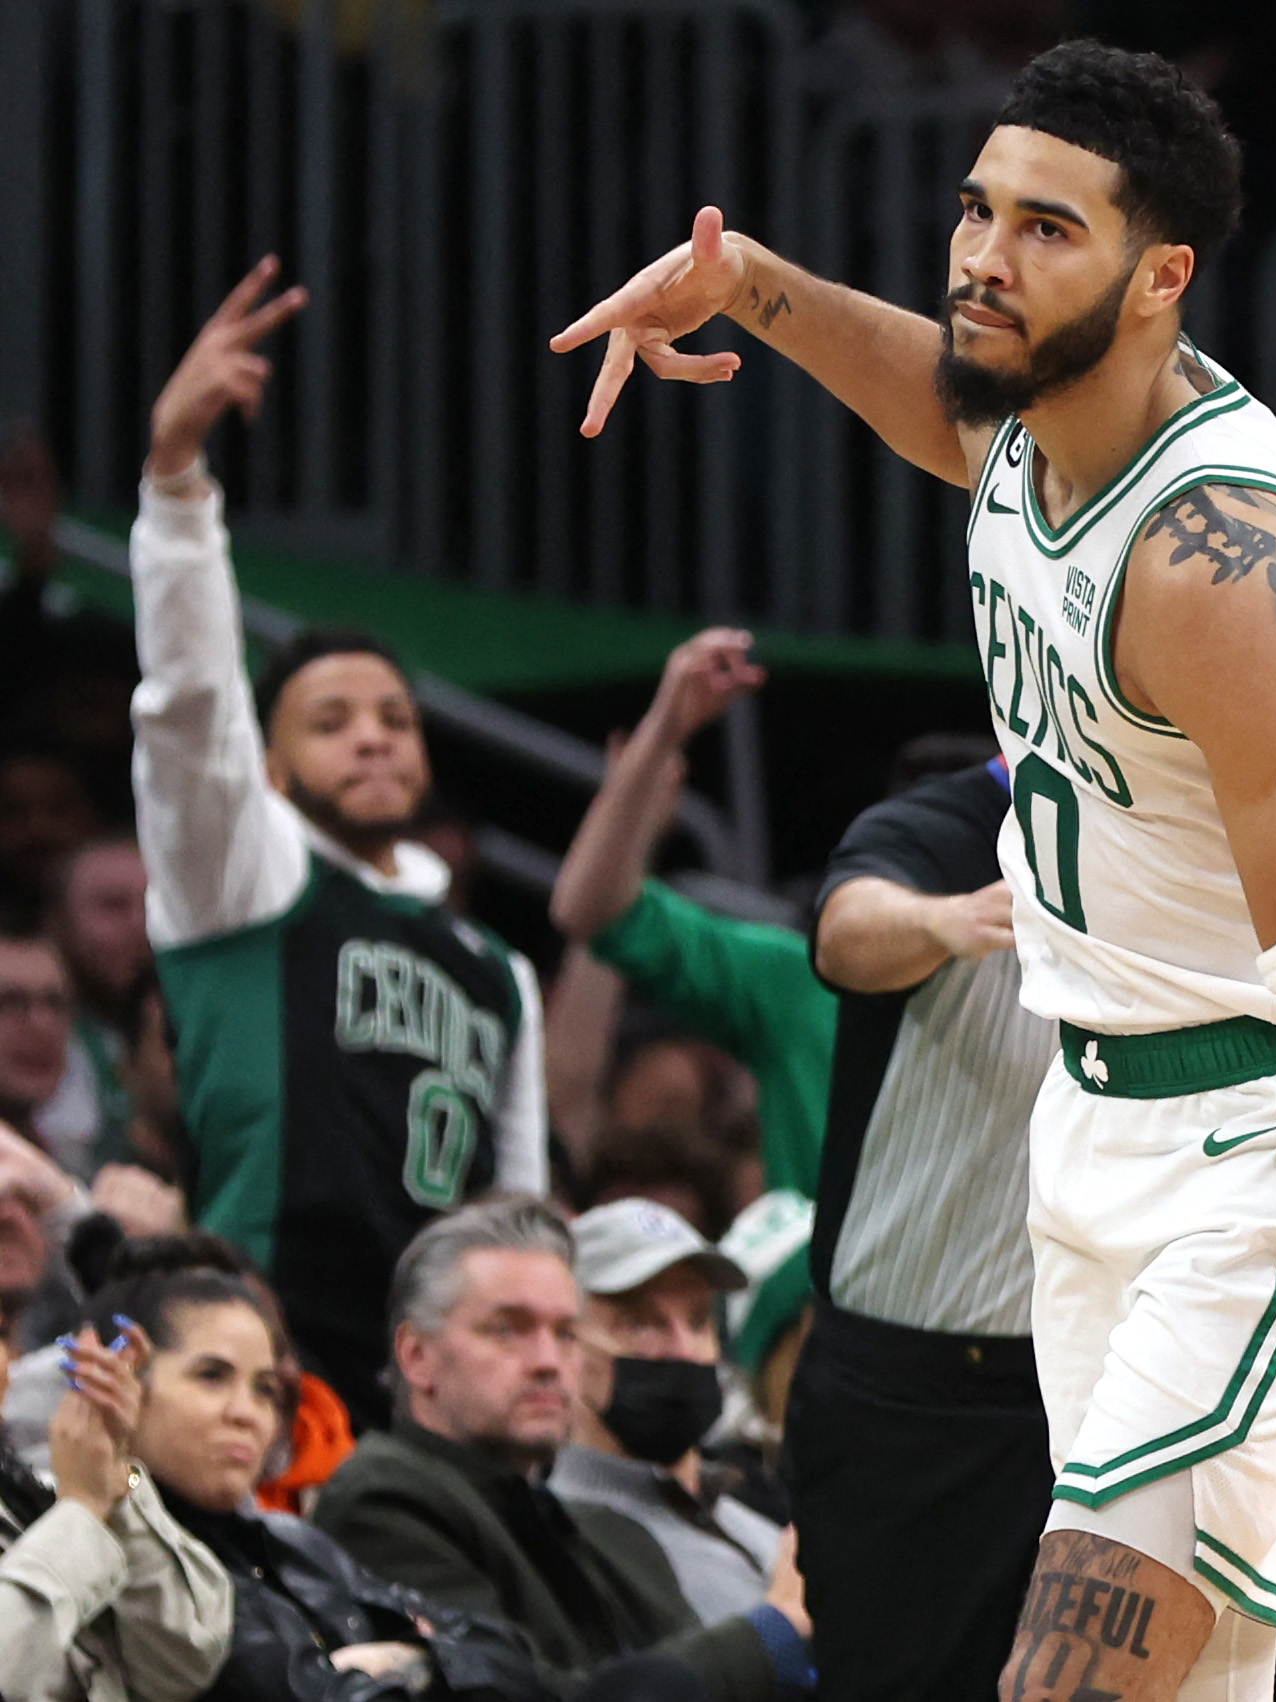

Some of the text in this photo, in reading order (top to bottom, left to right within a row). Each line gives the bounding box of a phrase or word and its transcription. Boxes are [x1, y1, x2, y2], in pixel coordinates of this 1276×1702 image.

[1062, 595, 1090, 637] PRINT
[1066, 565, 1096, 615] VISTA
[1013, 750, 1088, 934] 0
[402, 1070, 477, 1212] 0
[1024, 1571, 1156, 1660] TEFUL
